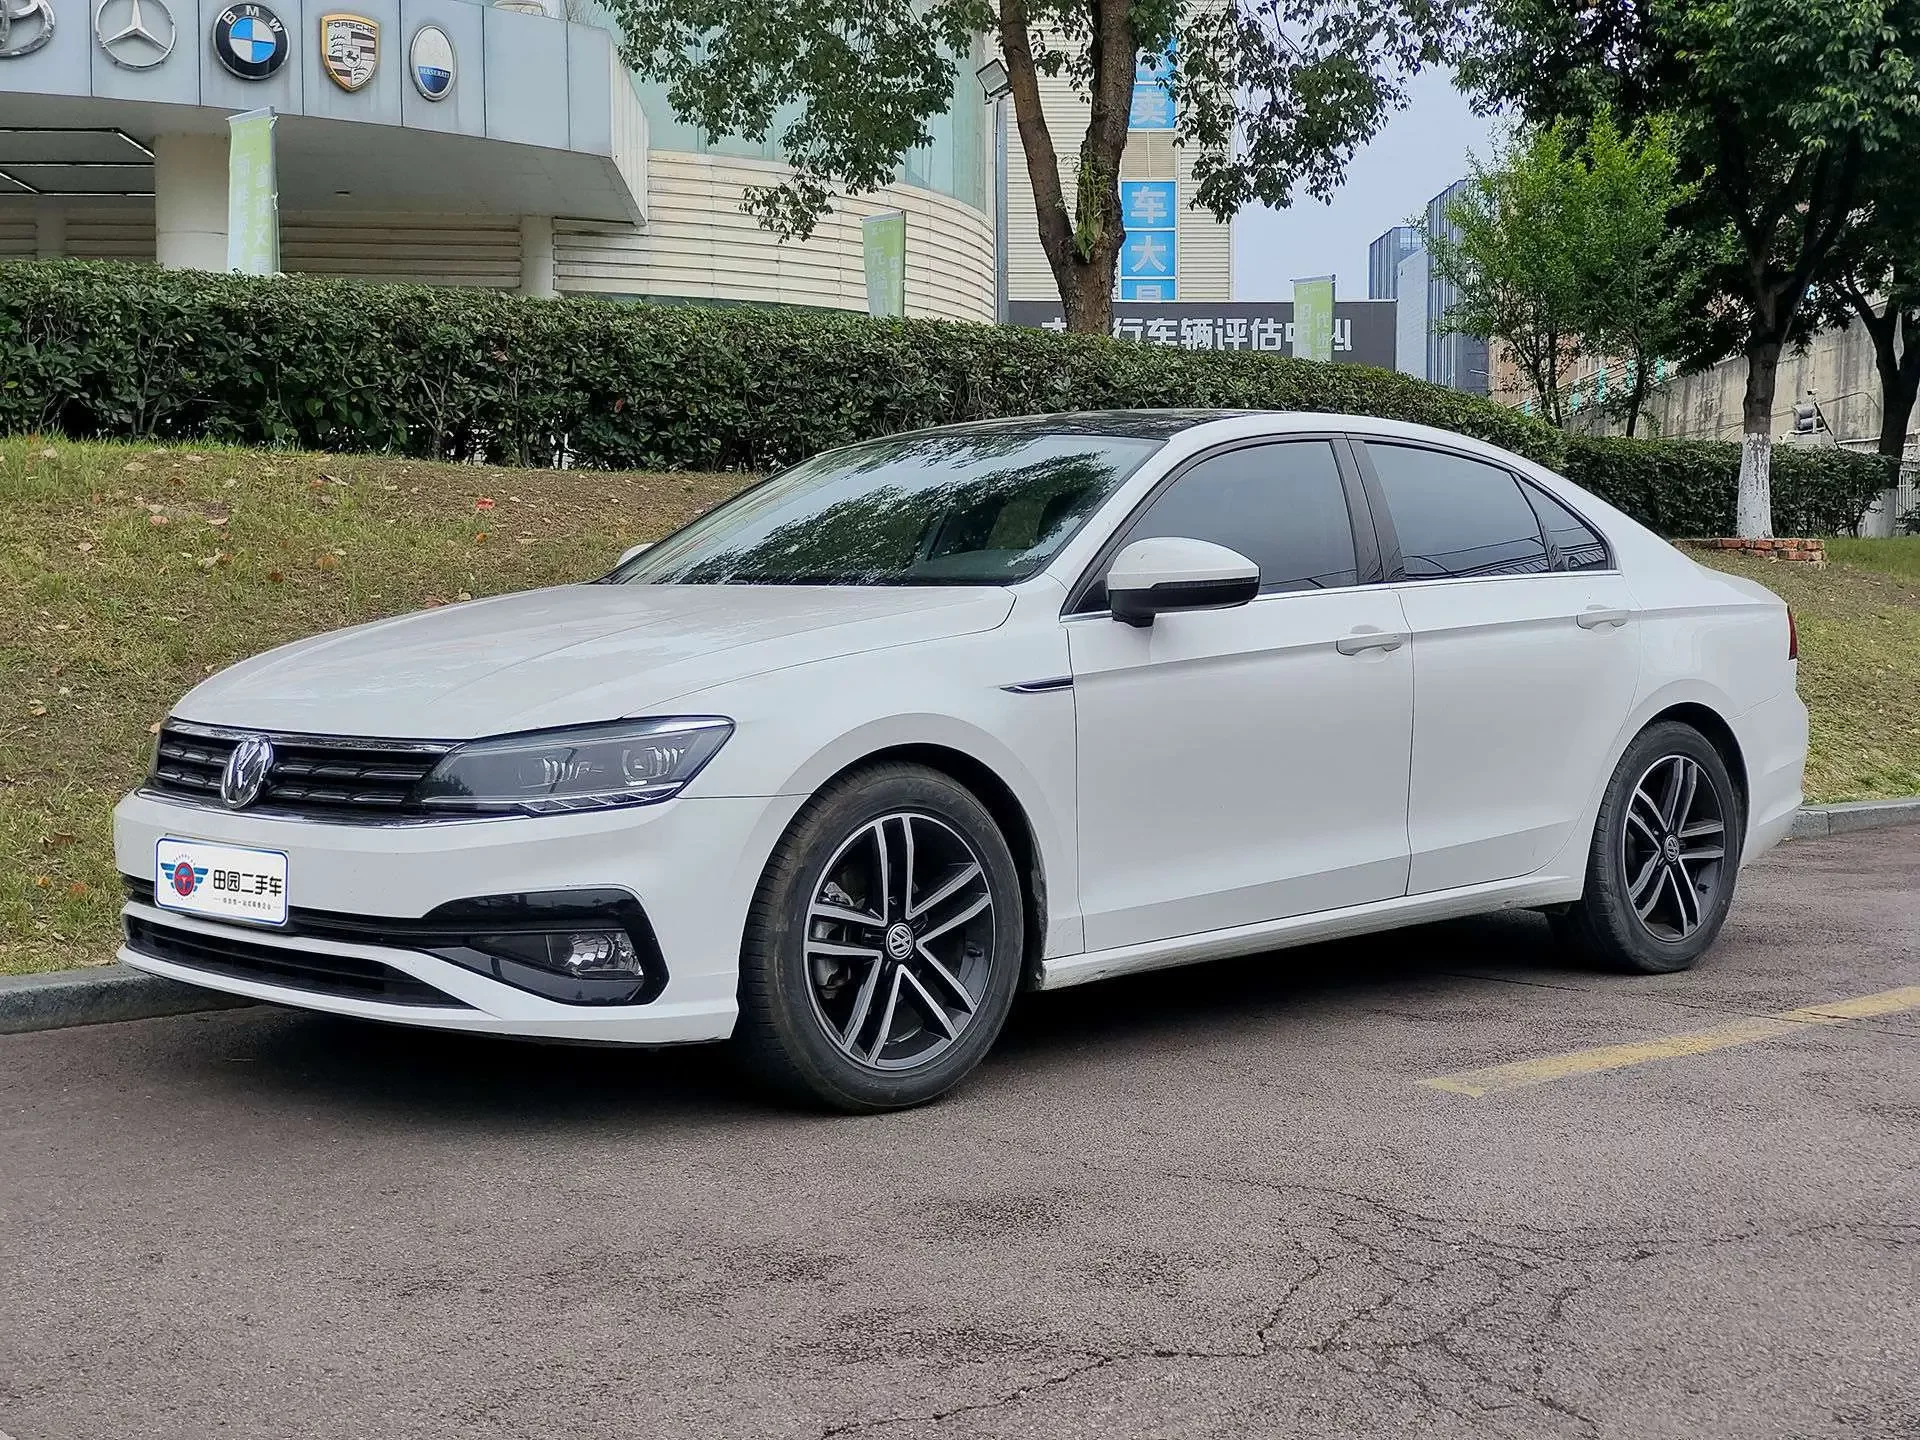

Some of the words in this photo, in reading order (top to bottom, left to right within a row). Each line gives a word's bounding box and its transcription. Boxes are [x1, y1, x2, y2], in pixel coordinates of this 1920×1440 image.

[222, 5, 283, 32] BMW
[327, 21, 376, 34] PORSCHE
[213, 869, 282, 897] 田园二手车
